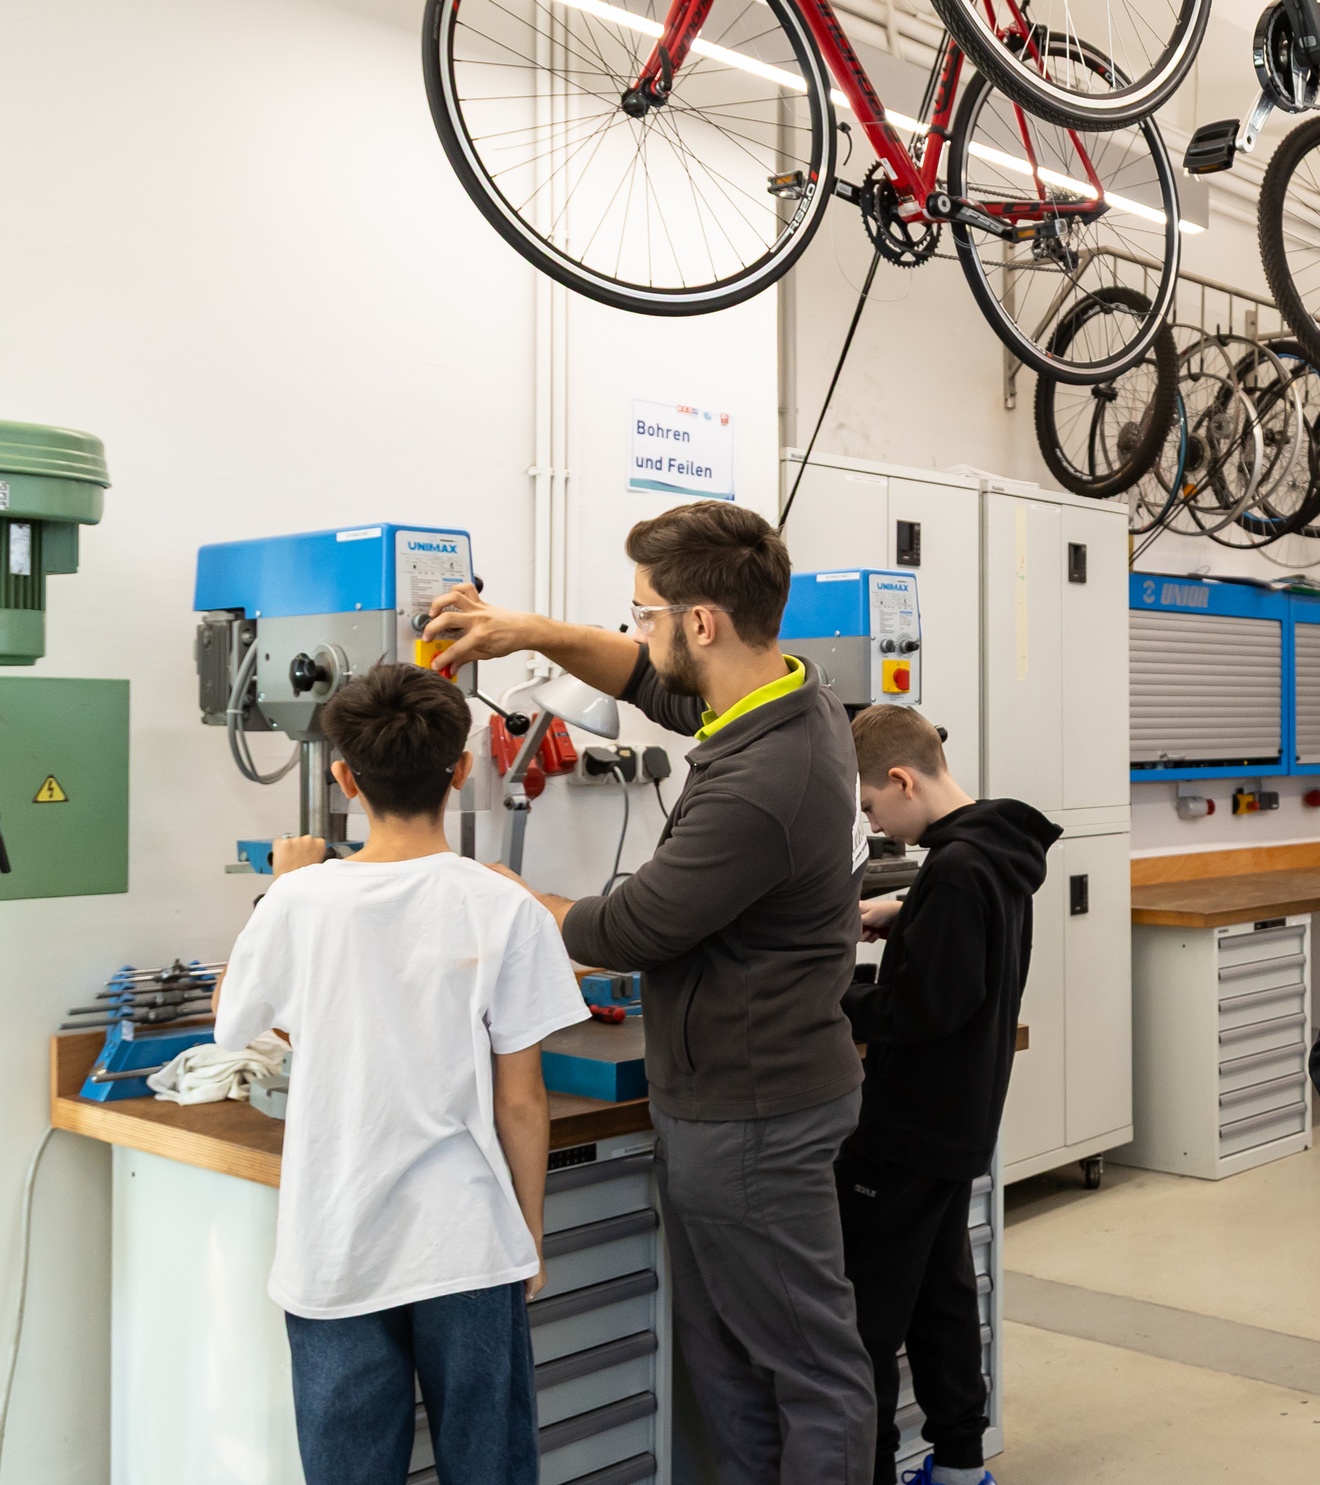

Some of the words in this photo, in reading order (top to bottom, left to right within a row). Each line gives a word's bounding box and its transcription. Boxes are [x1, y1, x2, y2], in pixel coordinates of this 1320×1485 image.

[637, 420, 690, 442] Bohren
[636, 456, 662, 471] und
[668, 458, 712, 478] Feilen
[407, 541, 457, 554] UNIMAX
[877, 582, 909, 592] UNIMAX
